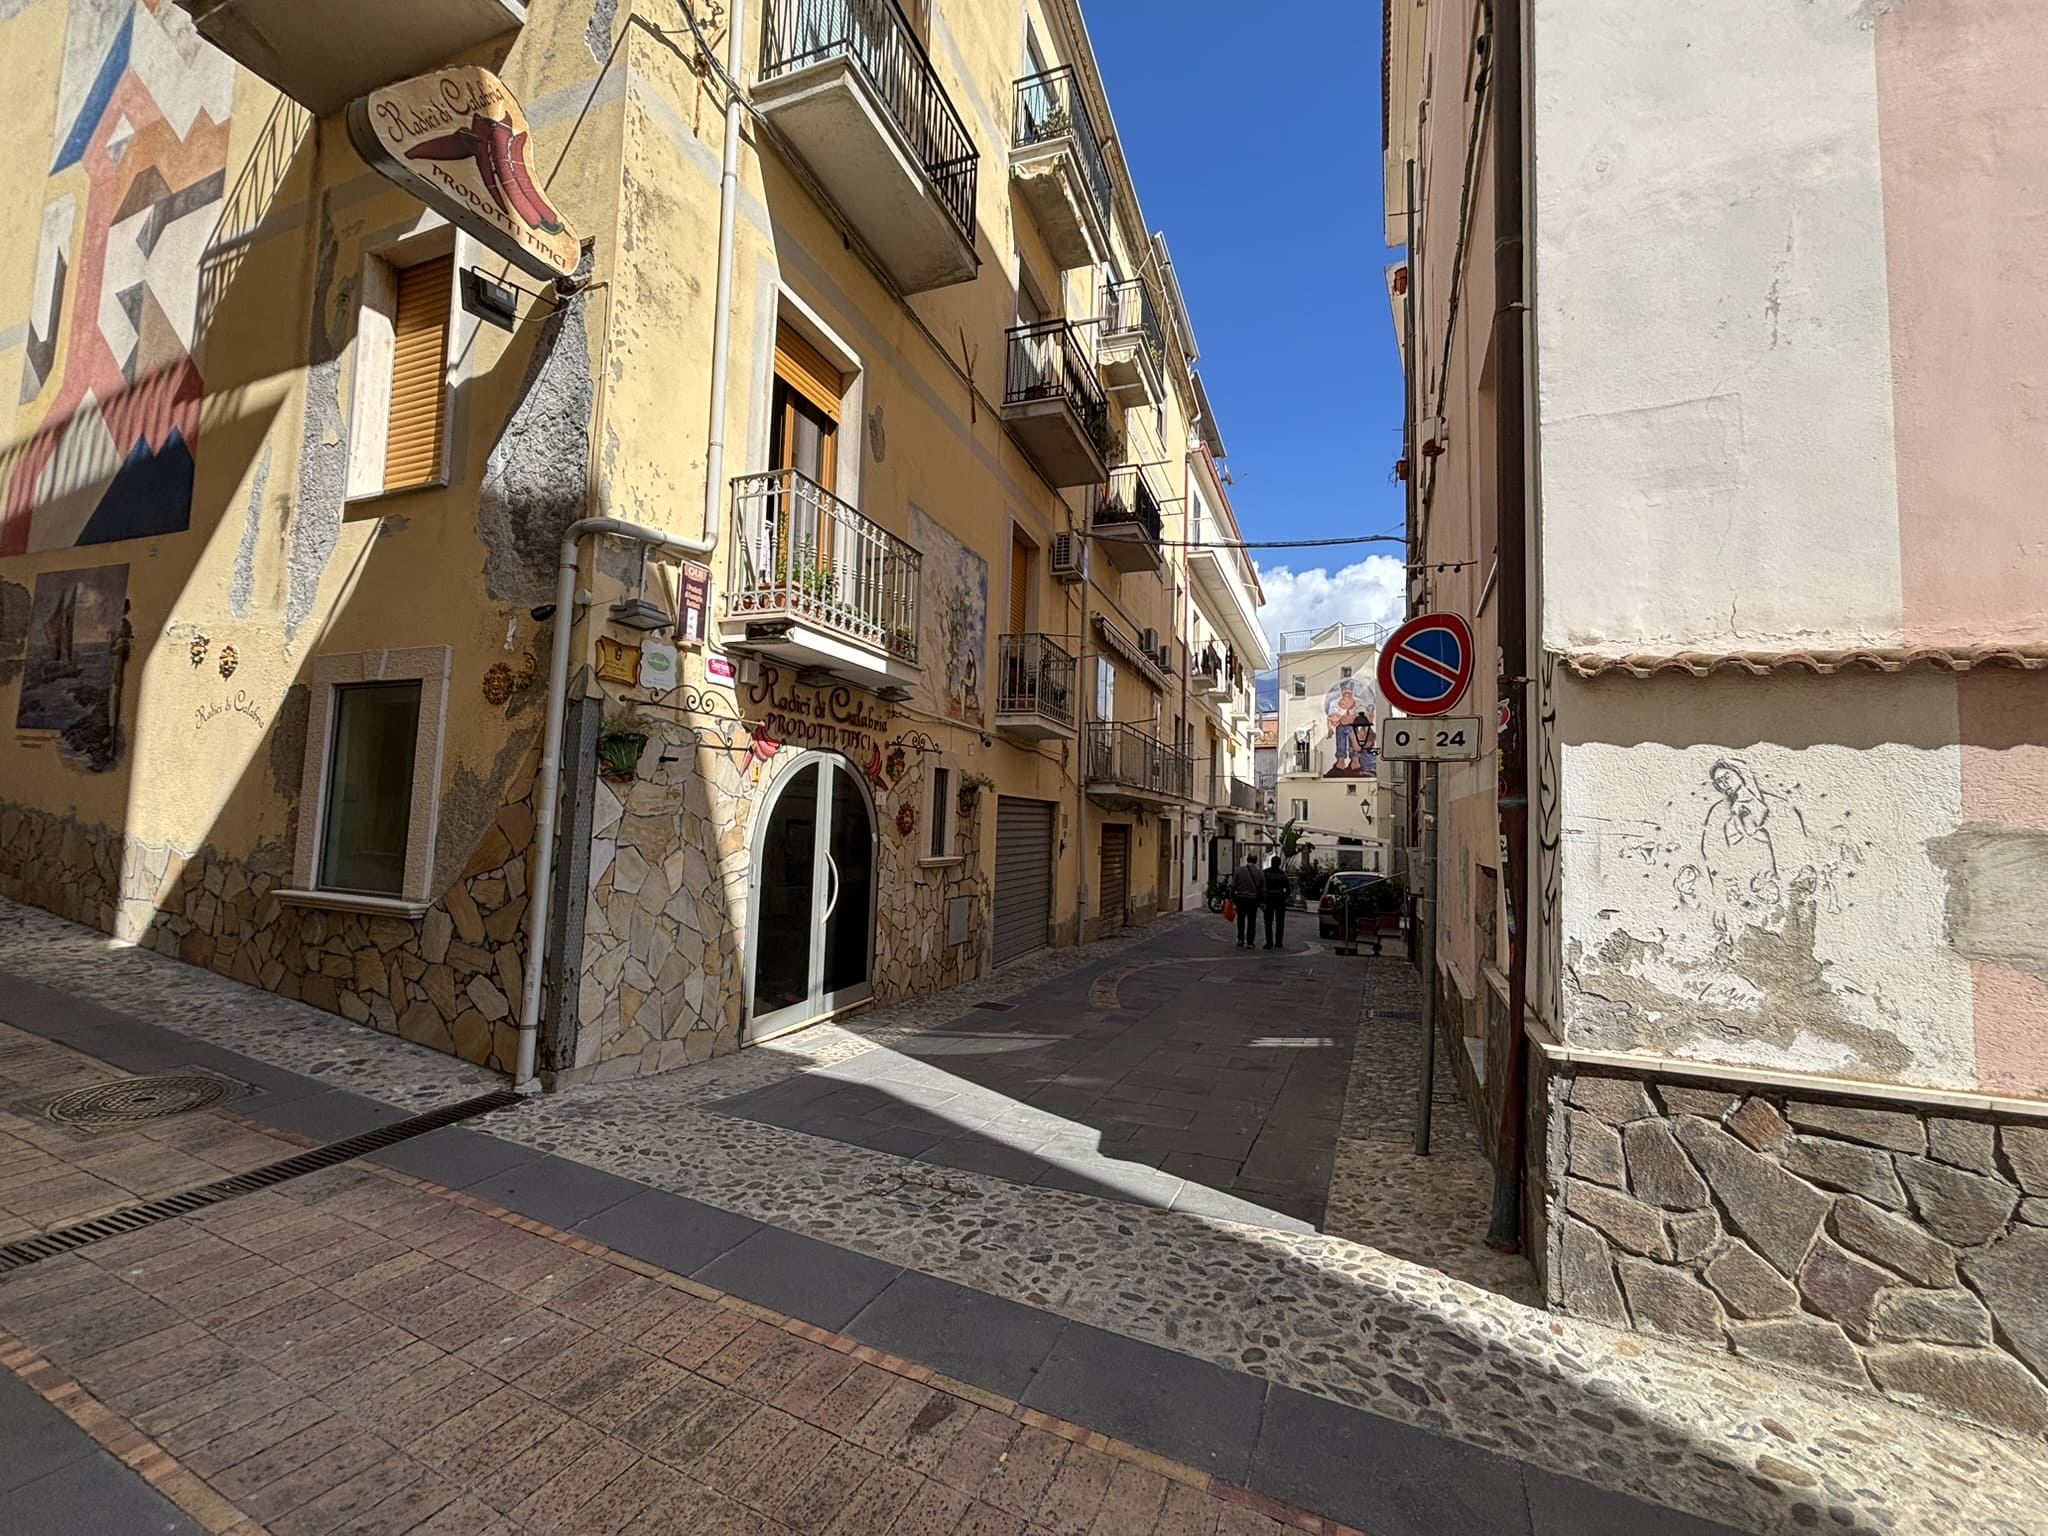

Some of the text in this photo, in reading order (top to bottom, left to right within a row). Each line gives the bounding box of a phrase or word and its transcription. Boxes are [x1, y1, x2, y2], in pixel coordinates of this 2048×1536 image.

[376, 78, 504, 142] Radici di Calabria
[432, 163, 566, 268] PRODOTTI TIPICI
[749, 664, 811, 716] Radici
[815, 691, 826, 718] di
[830, 686, 887, 732] Calabria
[766, 712, 871, 750] PRODOTTI TIPICI
[1395, 731, 1410, 747] 0
[1436, 731, 1465, 747] 24
